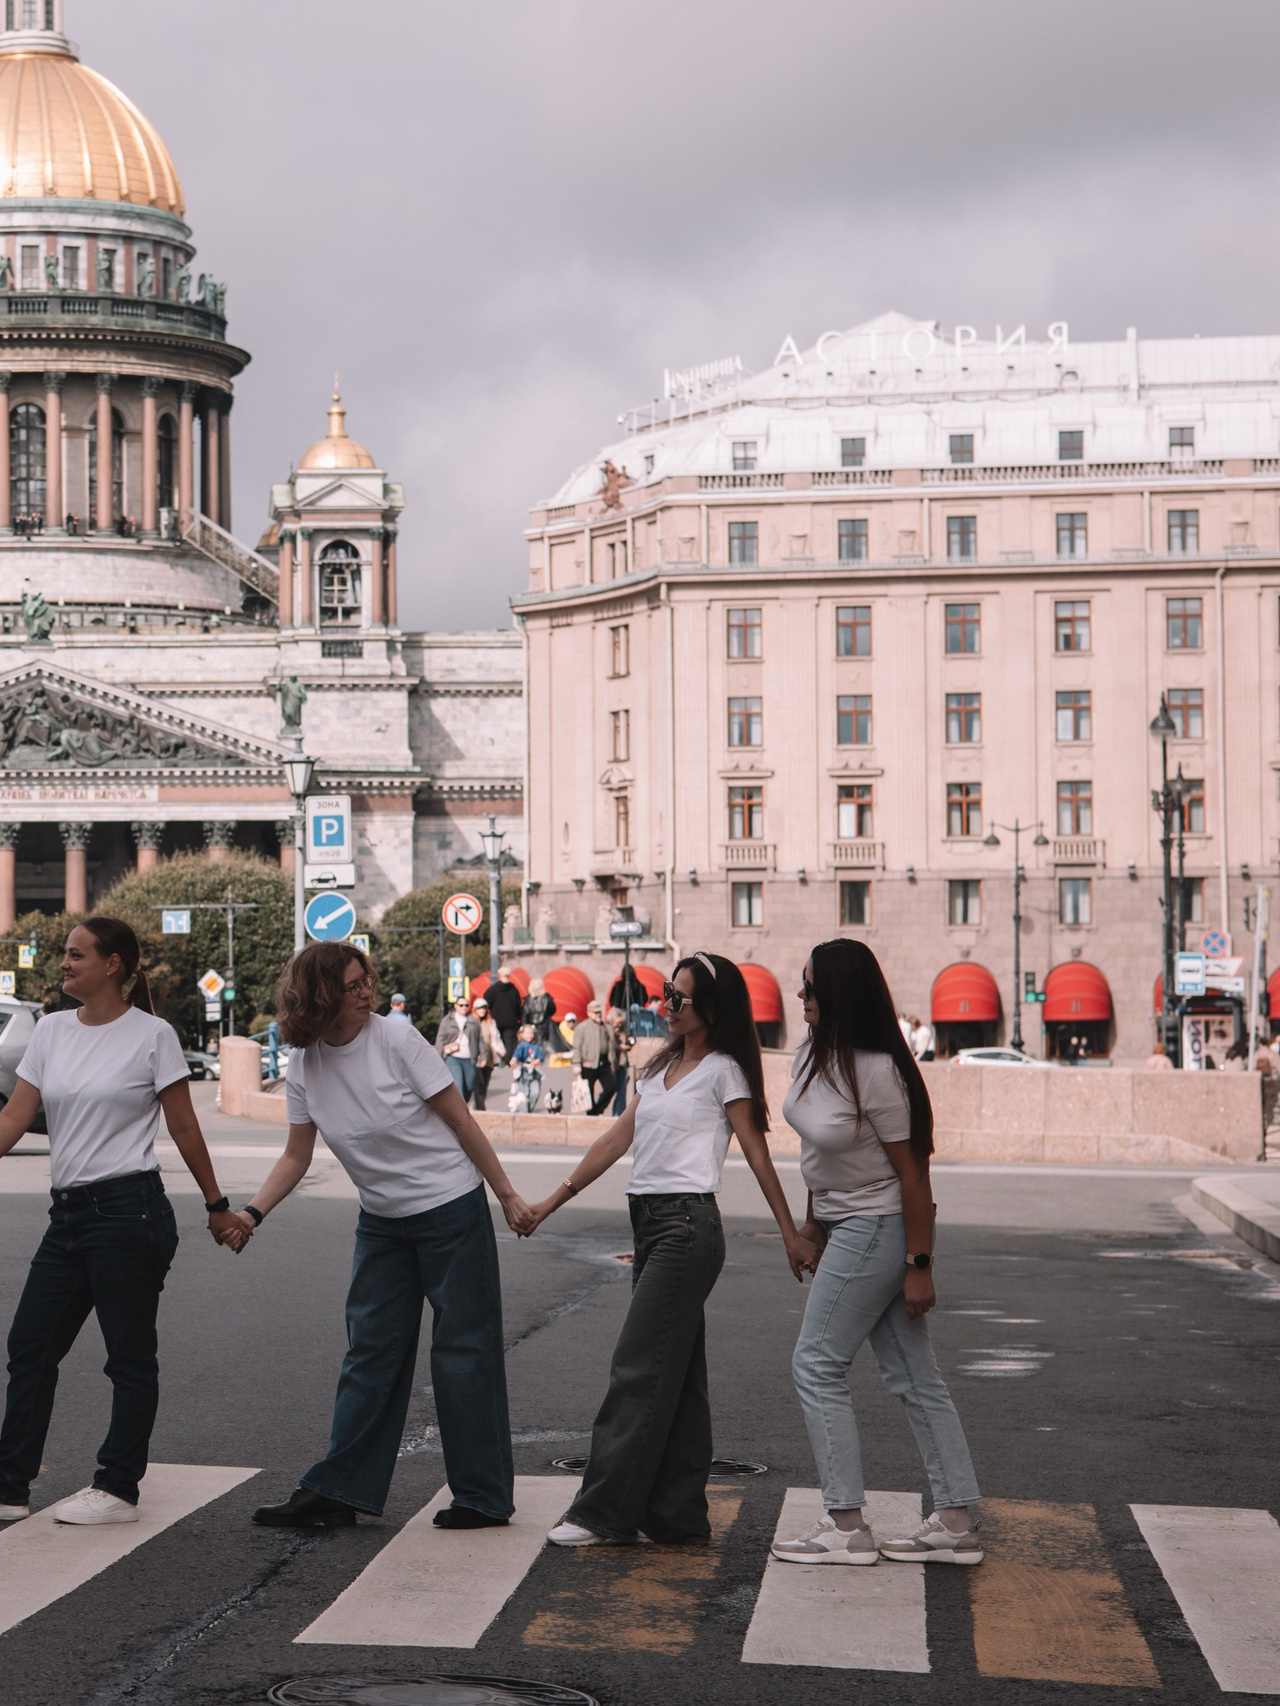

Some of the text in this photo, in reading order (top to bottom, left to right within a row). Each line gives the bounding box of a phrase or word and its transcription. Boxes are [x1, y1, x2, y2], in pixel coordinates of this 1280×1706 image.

[773, 321, 1069, 366] АСТОРИЯ
[316, 801, 341, 809] ЗОНА
[321, 818, 339, 844] P
